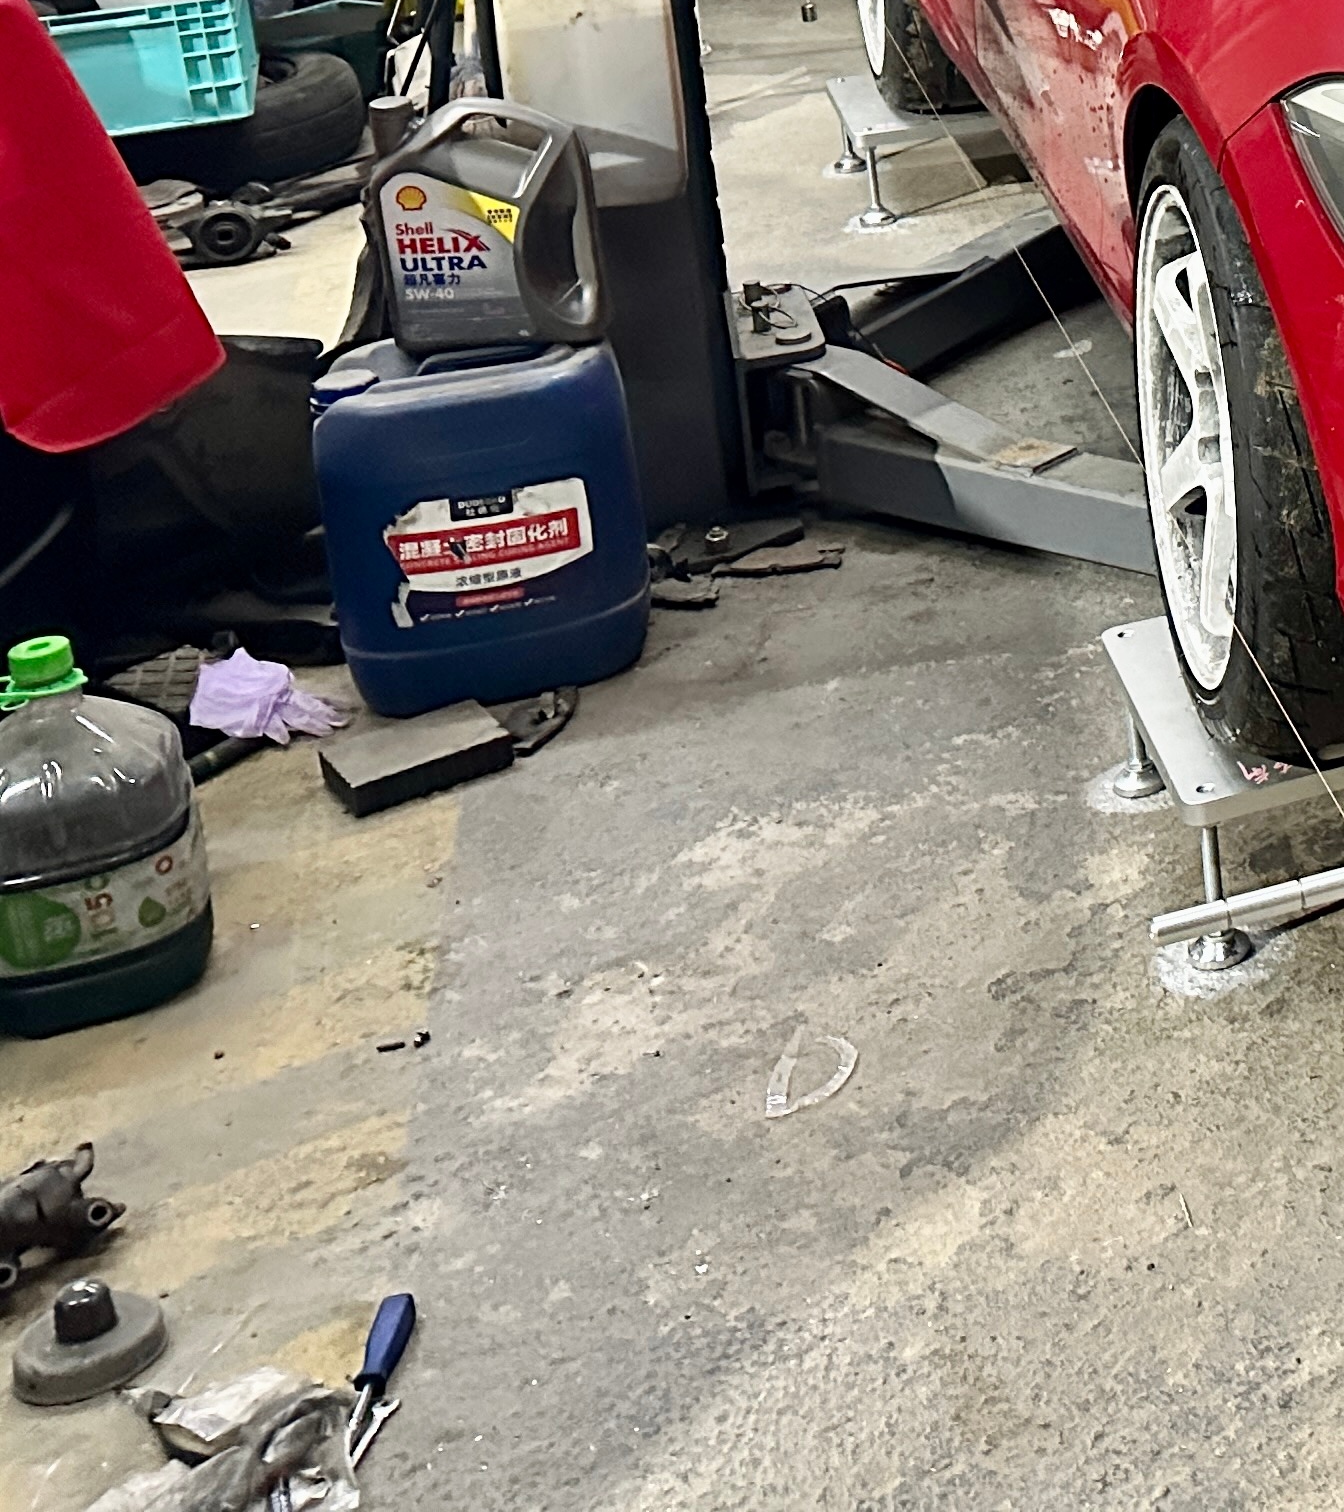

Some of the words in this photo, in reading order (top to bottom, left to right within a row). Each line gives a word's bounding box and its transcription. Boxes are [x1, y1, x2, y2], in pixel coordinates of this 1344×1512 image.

[395, 221, 434, 236] Shell
[396, 234, 491, 255] HELIX
[400, 255, 487, 272] ULTRA
[404, 289, 455, 300] 5W-40
